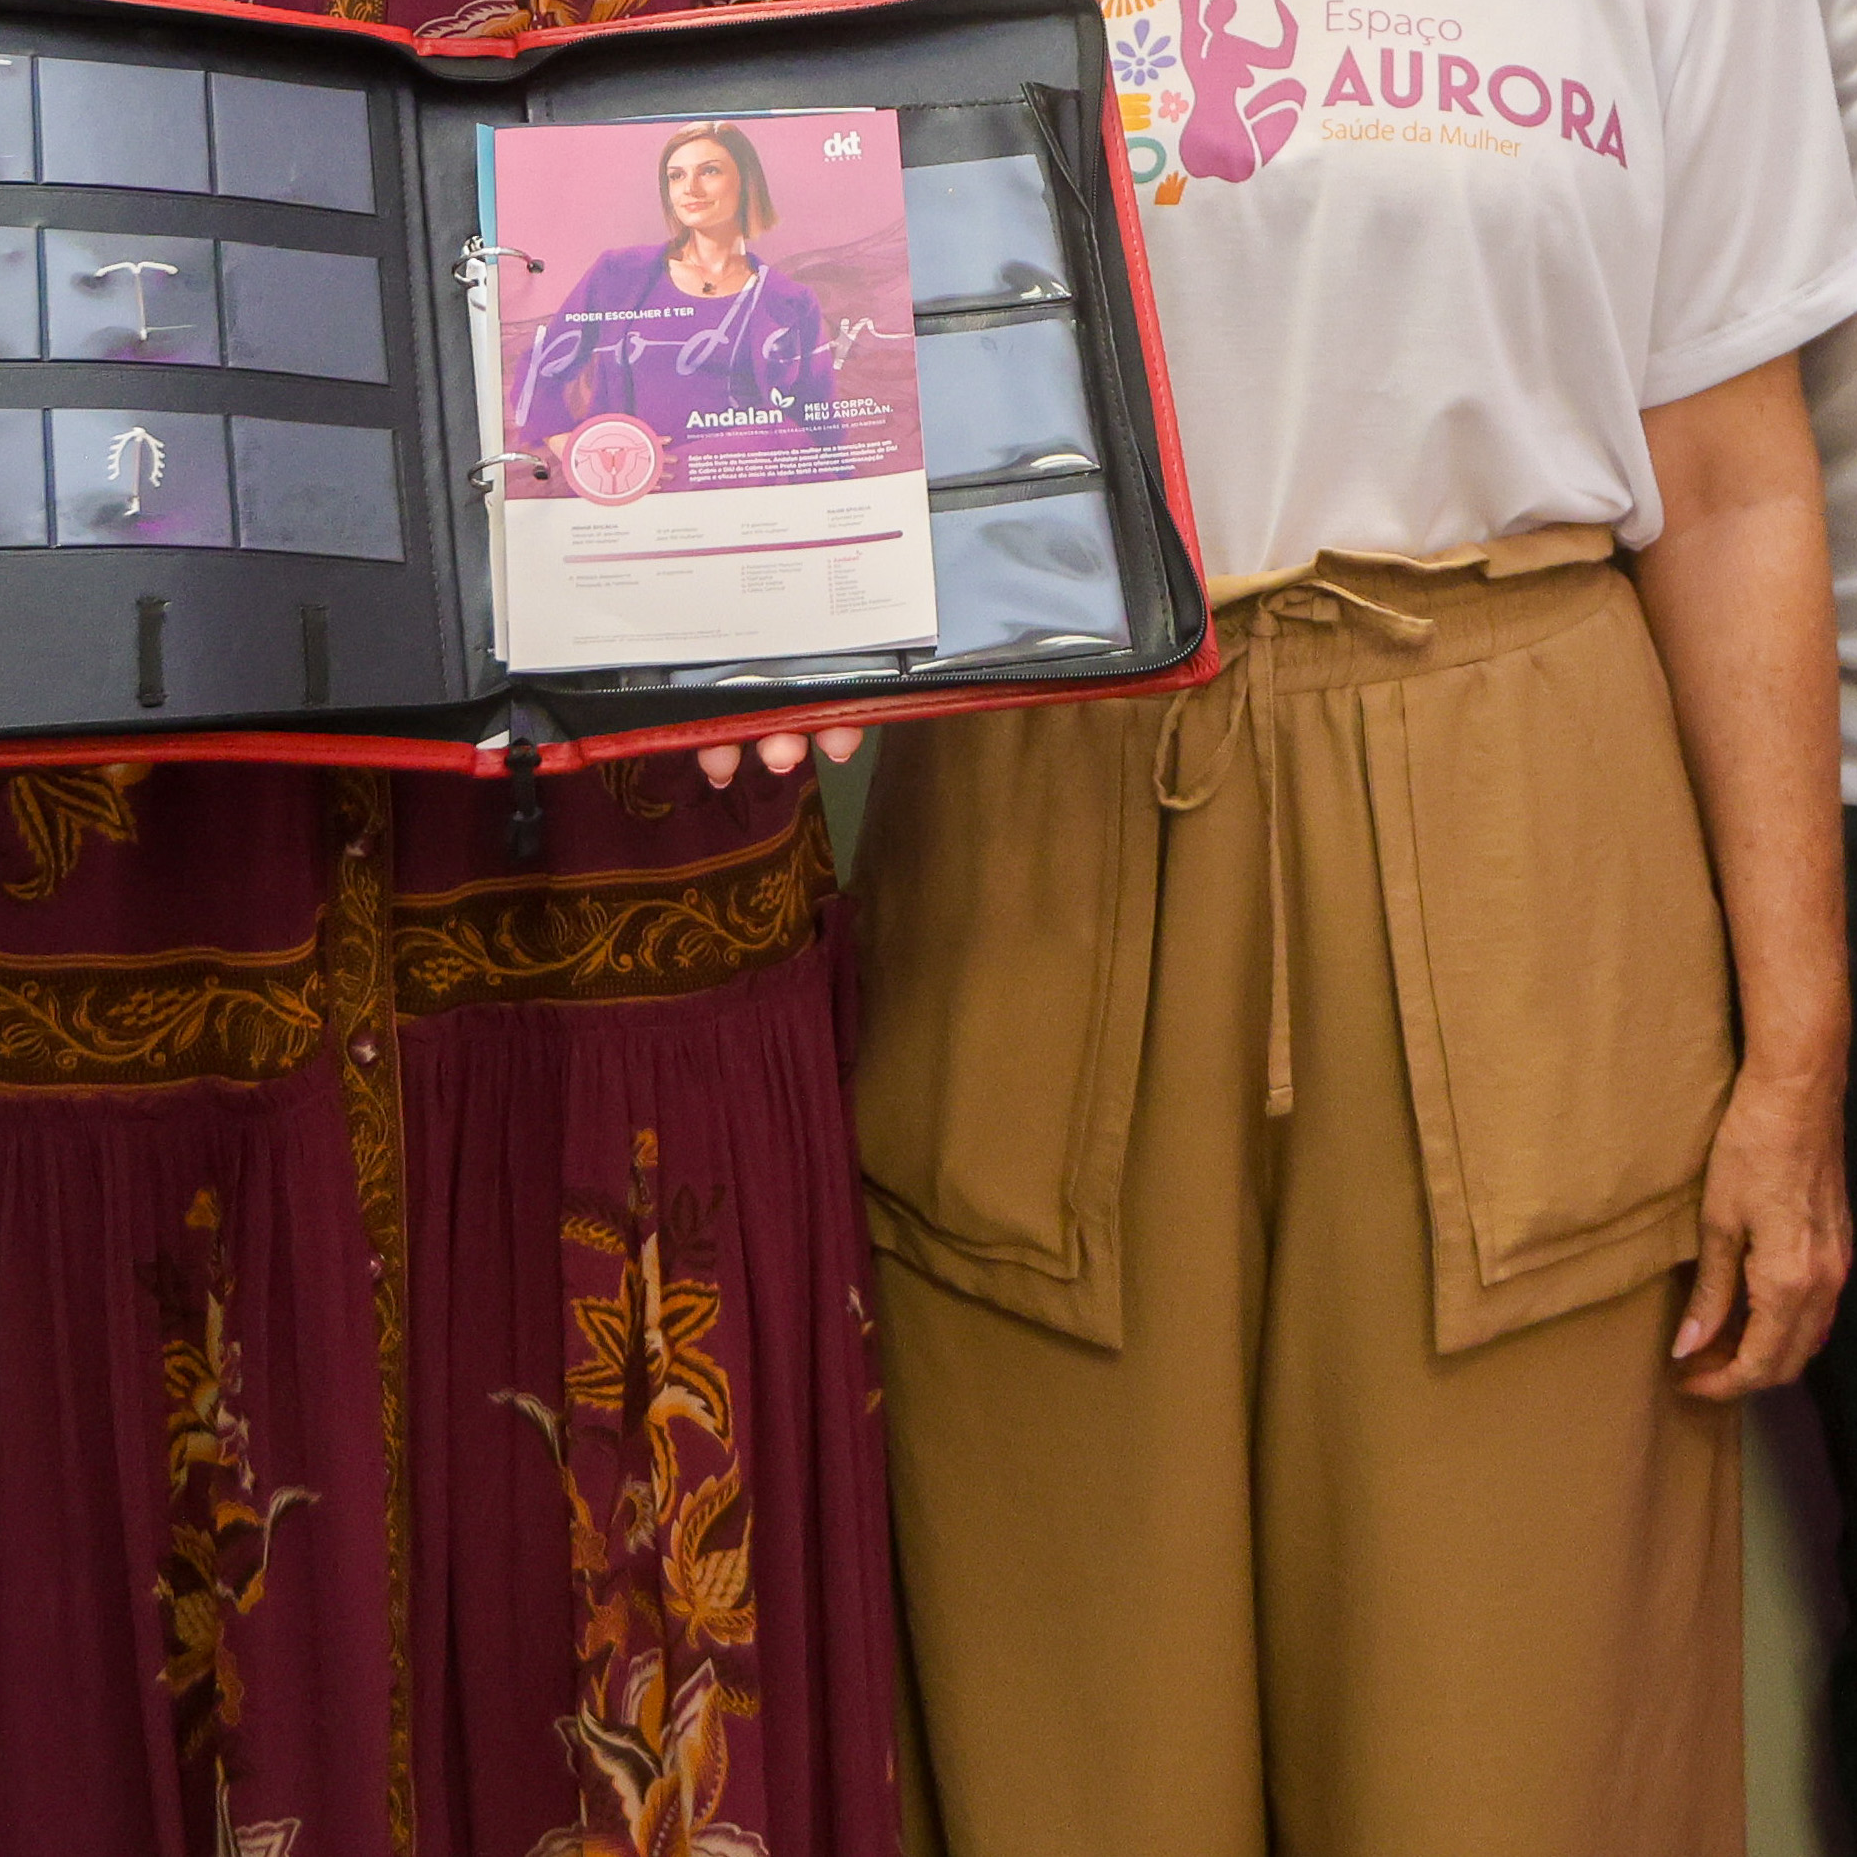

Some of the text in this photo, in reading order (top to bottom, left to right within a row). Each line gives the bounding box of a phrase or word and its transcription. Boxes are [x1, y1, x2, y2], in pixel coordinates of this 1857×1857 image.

[1325, 0, 1463, 46] Espaço
[1321, 45, 1628, 170] AURORA
[824, 131, 862, 157] dkt
[1321, 118, 1522, 157] Saúde da Mulher
[565, 306, 694, 322] PODER ESCOLHER É TER
[804, 398, 877, 412] MEU CORPO,
[804, 405, 894, 421] MEU ANDALAN.
[686, 407, 783, 428] Andalan
